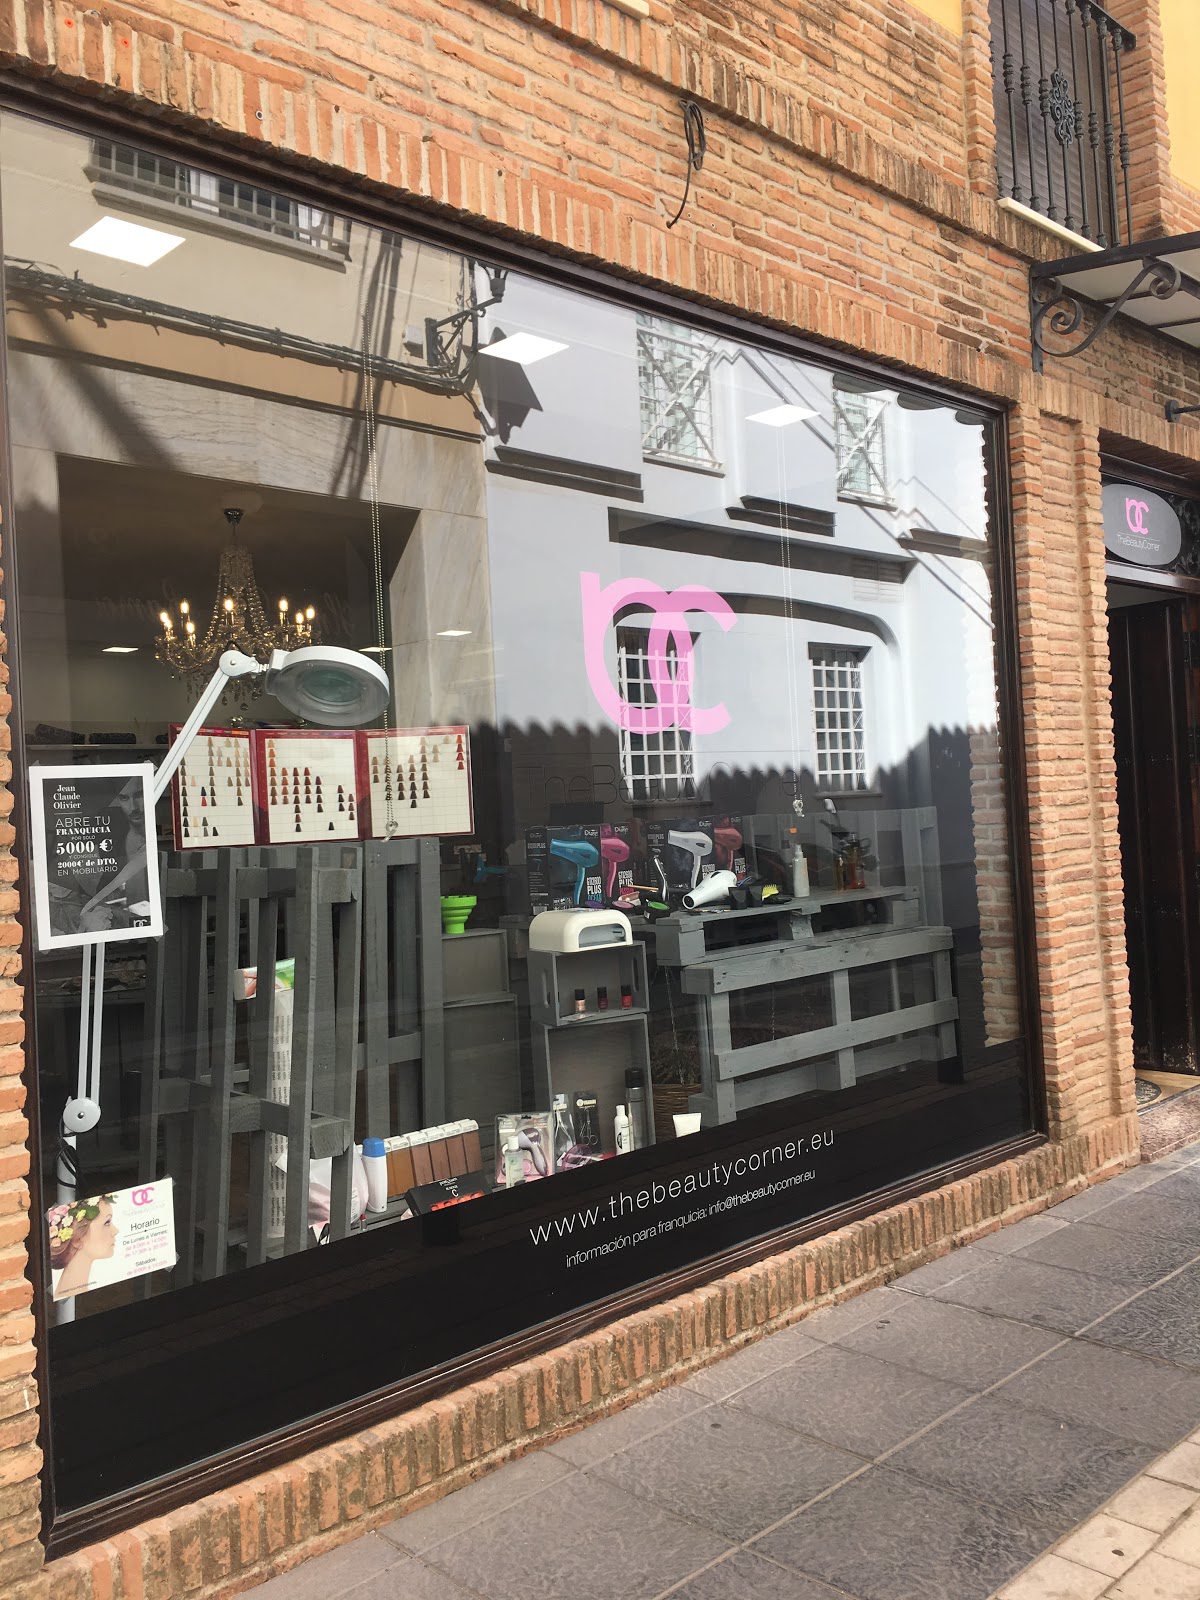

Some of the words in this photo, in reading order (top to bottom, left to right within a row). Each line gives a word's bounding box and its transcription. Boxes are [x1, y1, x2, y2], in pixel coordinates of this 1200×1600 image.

[57, 784, 76, 792] Jean
[53, 792, 81, 801] Claude
[53, 801, 82, 810] Olivier
[55, 816, 91, 828] ABRE
[95, 815, 111, 826] TU
[56, 826, 112, 836] FRANQUICIA
[56, 840, 95, 855] 5000
[99, 838, 113, 852] €
[57, 860, 84, 869] 2000€
[85, 859, 96, 867] de
[97, 857, 118, 866] DTO.
[57, 869, 69, 877] EN
[72, 865, 118, 875] MOBILIARIO
[586, 884, 602, 895] PLUS
[529, 1126, 835, 1247] www.thebeautycorner.eu
[130, 1217, 160, 1232] Horario
[565, 1234, 633, 1269] información
[632, 1225, 657, 1247] para
[657, 1206, 708, 1235] franquicia:
[708, 1168, 816, 1217] info@thebeautycorner.eu
